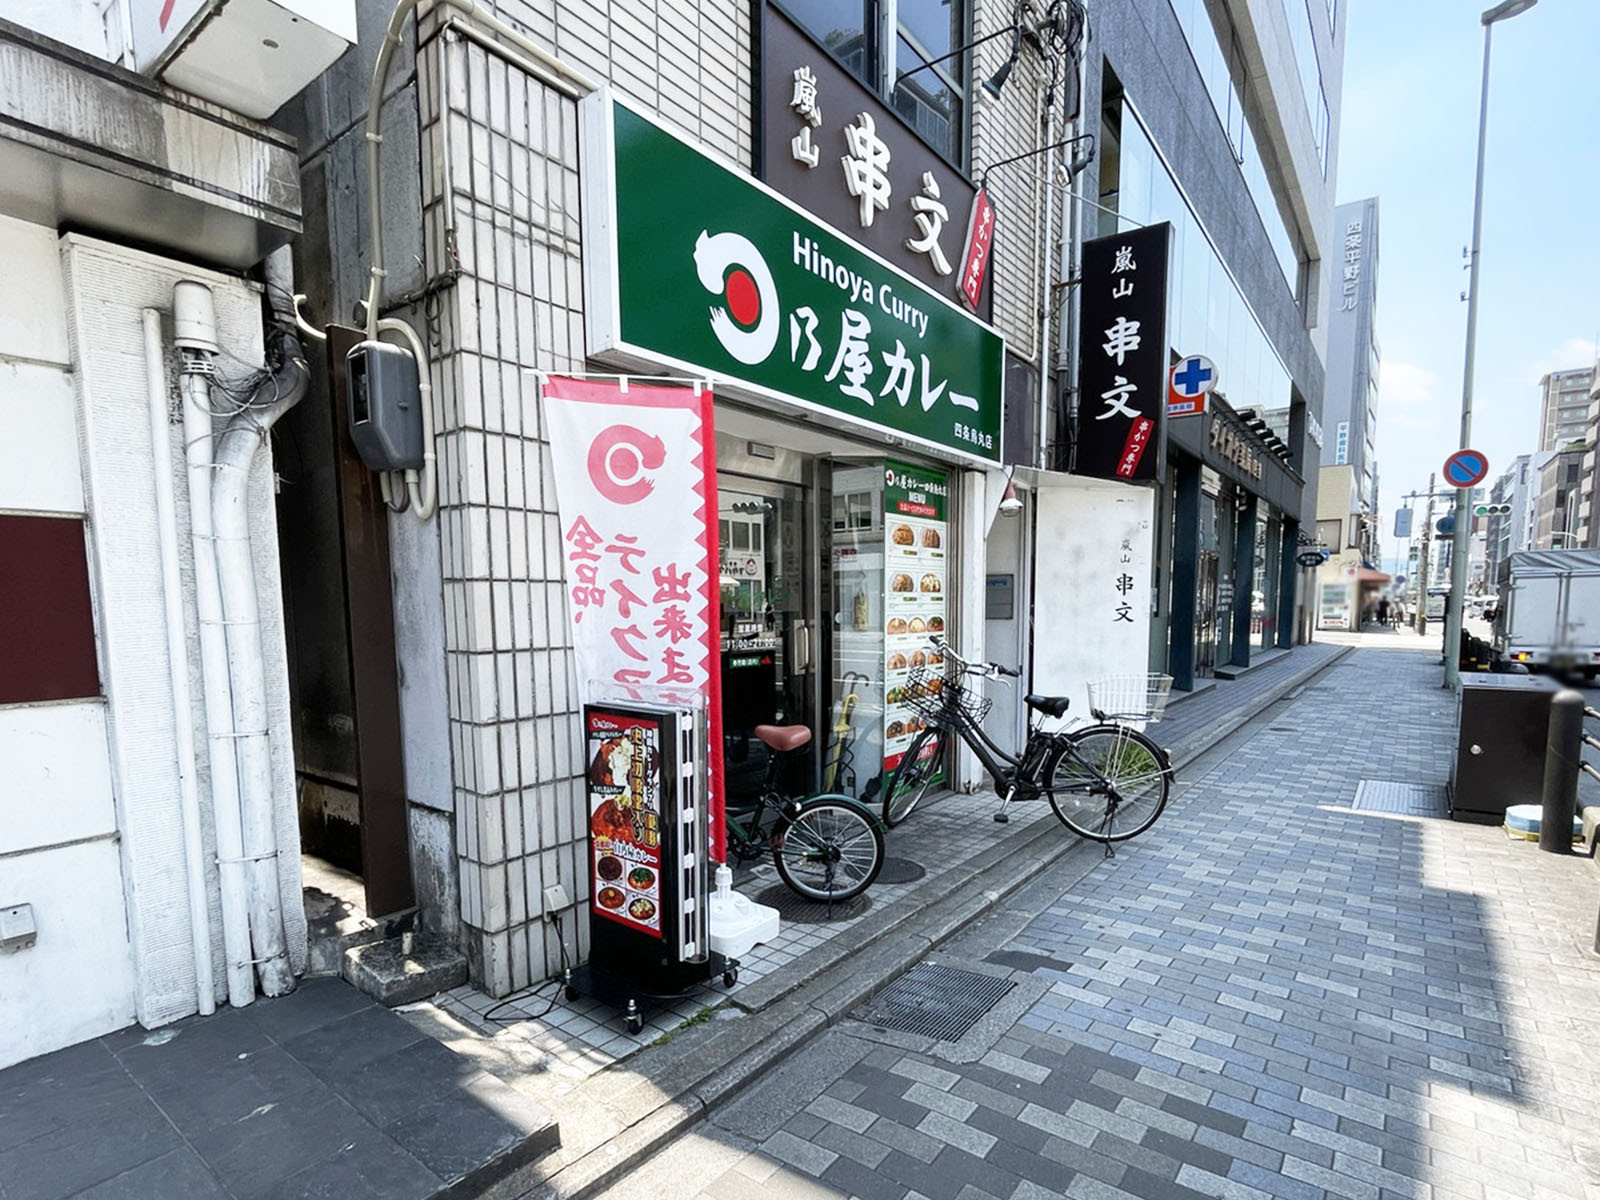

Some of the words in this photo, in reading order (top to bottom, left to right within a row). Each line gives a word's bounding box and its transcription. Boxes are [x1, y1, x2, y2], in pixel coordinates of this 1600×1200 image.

[841, 111, 953, 276] 串文
[793, 231, 875, 305] Hinoya
[879, 283, 930, 340] Curry
[1095, 316, 1143, 421] 串文
[954, 422, 993, 450] 四条烏丸店
[1112, 572, 1135, 623] 串文
